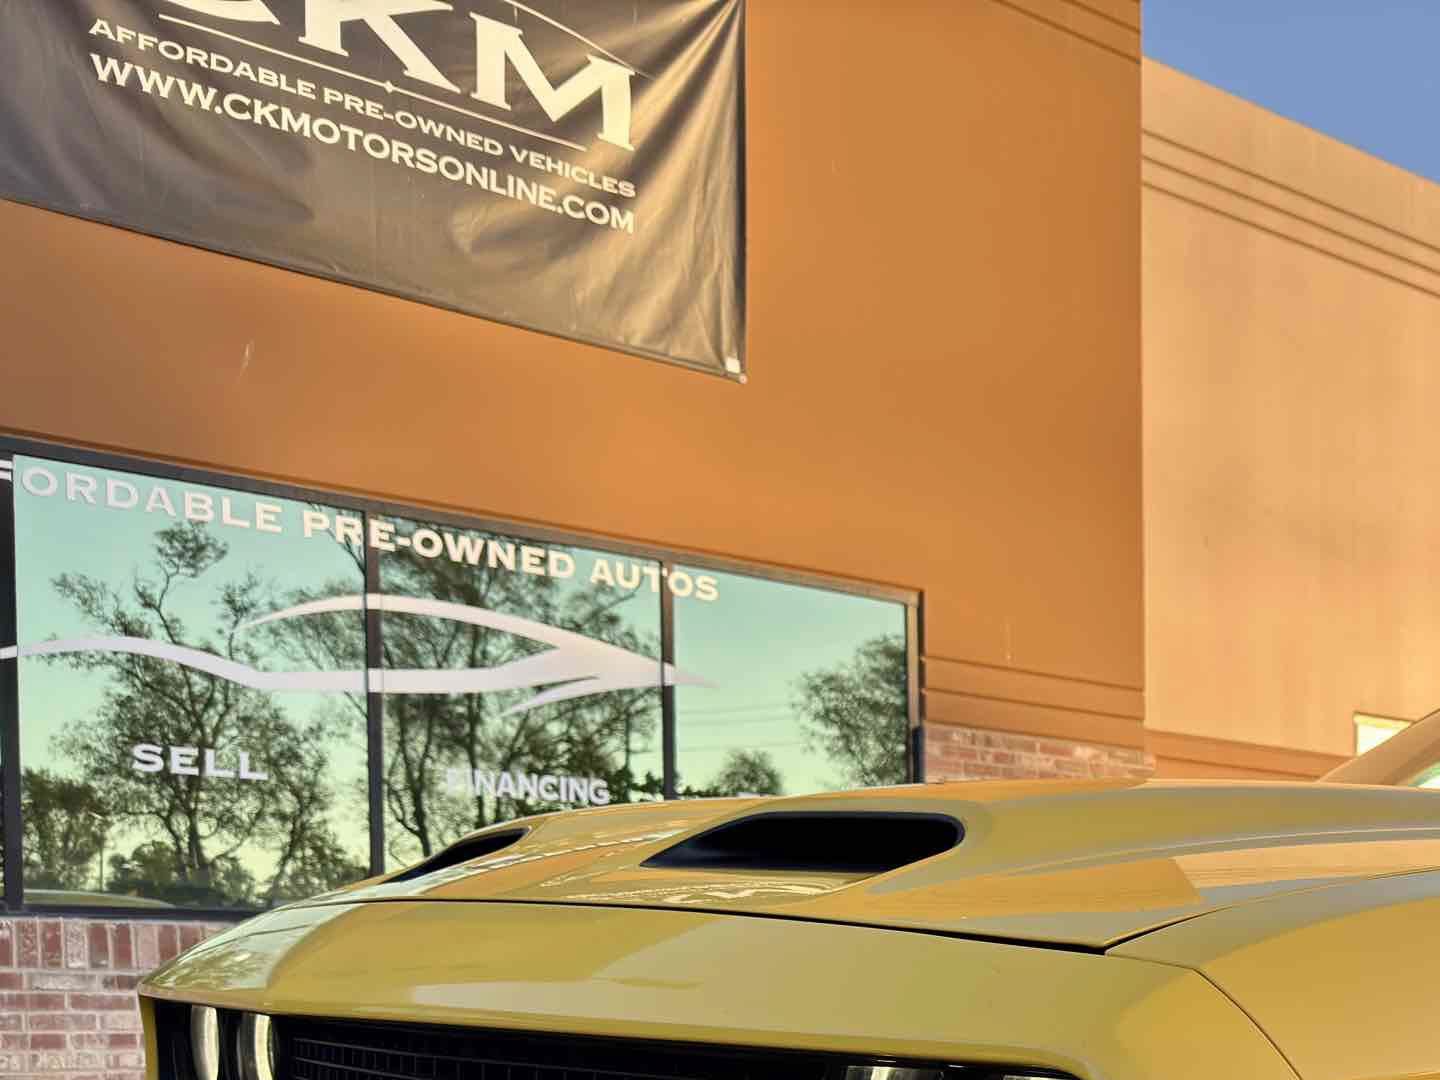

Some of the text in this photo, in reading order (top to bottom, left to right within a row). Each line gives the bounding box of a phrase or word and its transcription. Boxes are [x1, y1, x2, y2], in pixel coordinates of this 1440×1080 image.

[88, 19, 636, 198] AFFORDABLE PRE-OWNED VEHICLES
[167, 0, 635, 151] KM
[90, 53, 635, 233] WWW.CKMOTORSONLINE.COM
[302, 510, 576, 579] PRE-OWNED
[590, 558, 720, 602] AUTOS
[131, 743, 269, 781] SELL
[446, 767, 610, 805] FINANCING
